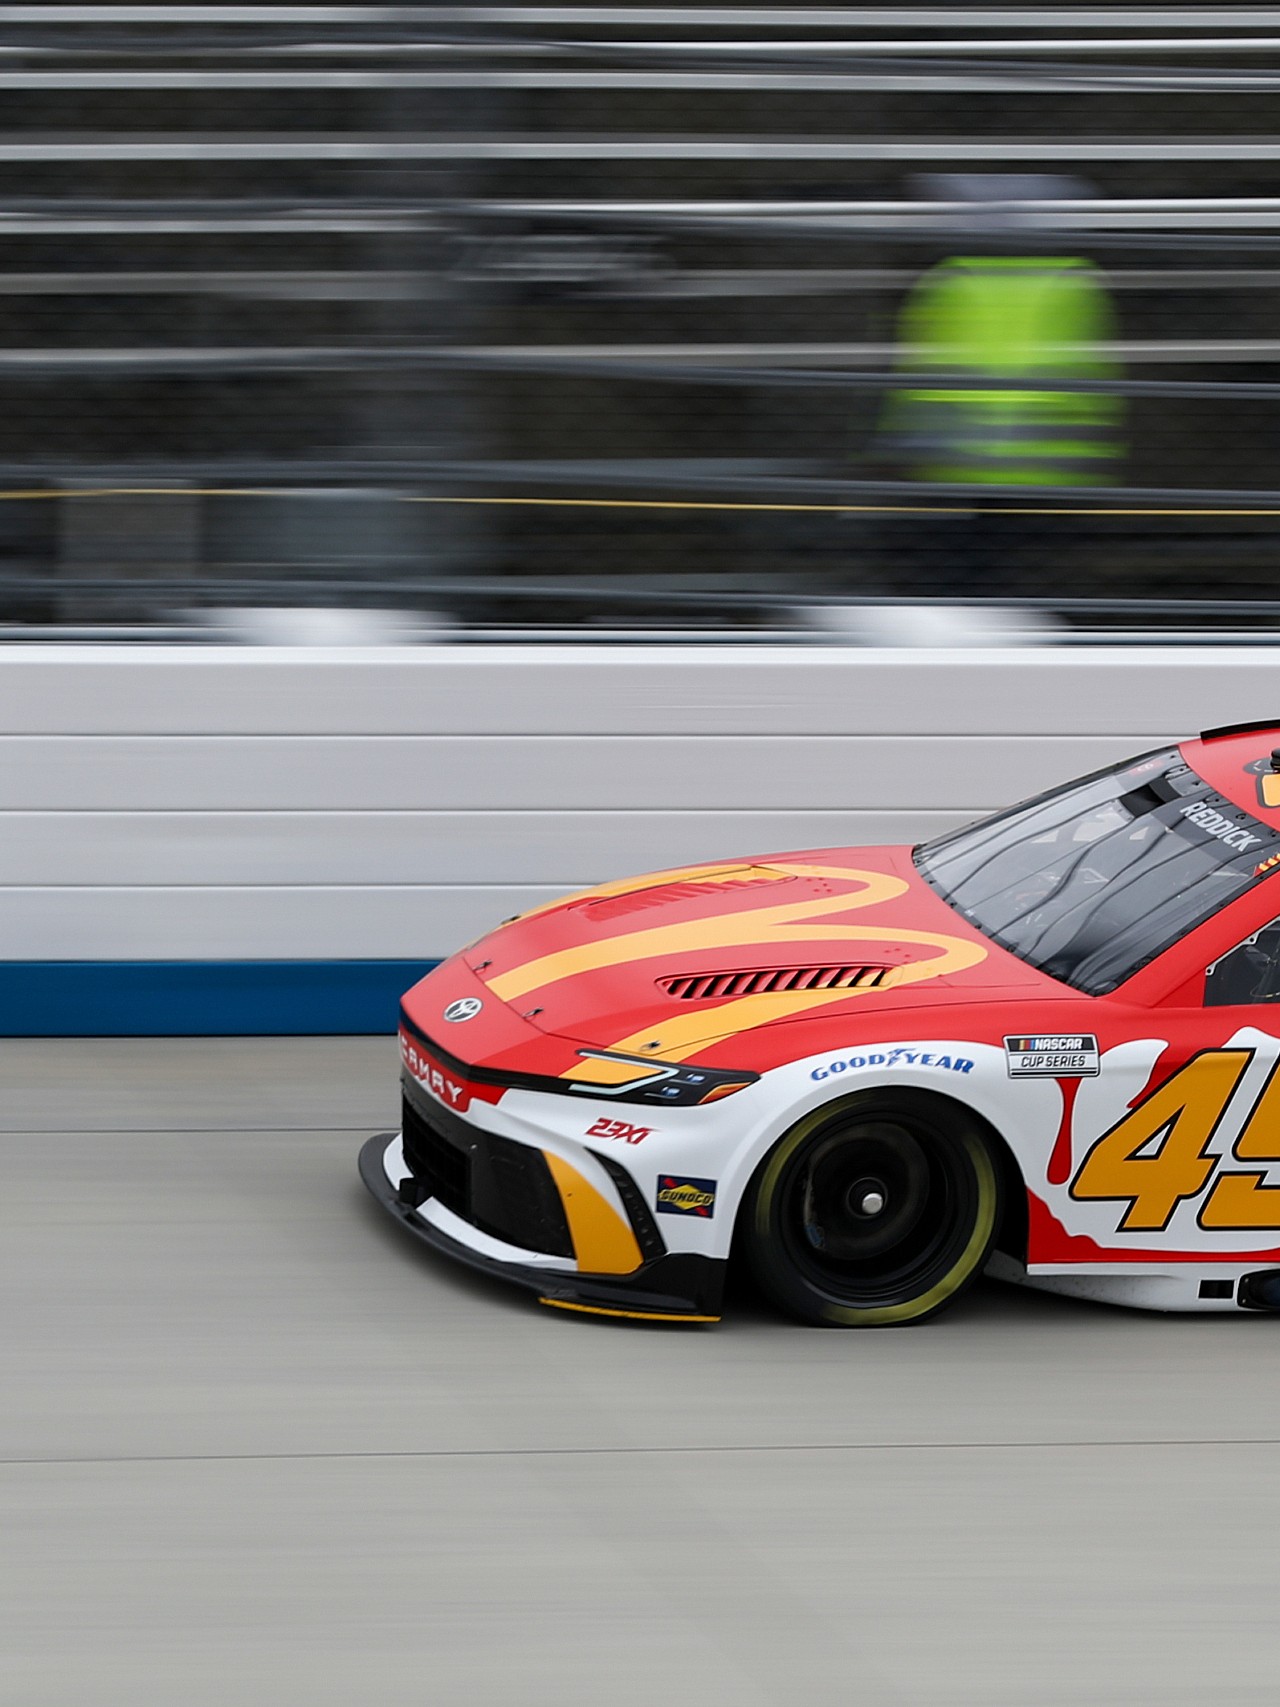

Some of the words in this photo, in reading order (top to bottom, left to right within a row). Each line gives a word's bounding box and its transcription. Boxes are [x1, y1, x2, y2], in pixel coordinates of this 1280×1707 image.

[1180, 801, 1262, 852] REDDICK
[1034, 1038, 1083, 1051] NASCAR
[811, 1048, 975, 1082] GOODYEAR
[1021, 1056, 1044, 1068] CUP
[1045, 1055, 1086, 1068] SERIES
[658, 1188, 714, 1206] SUNOCO
